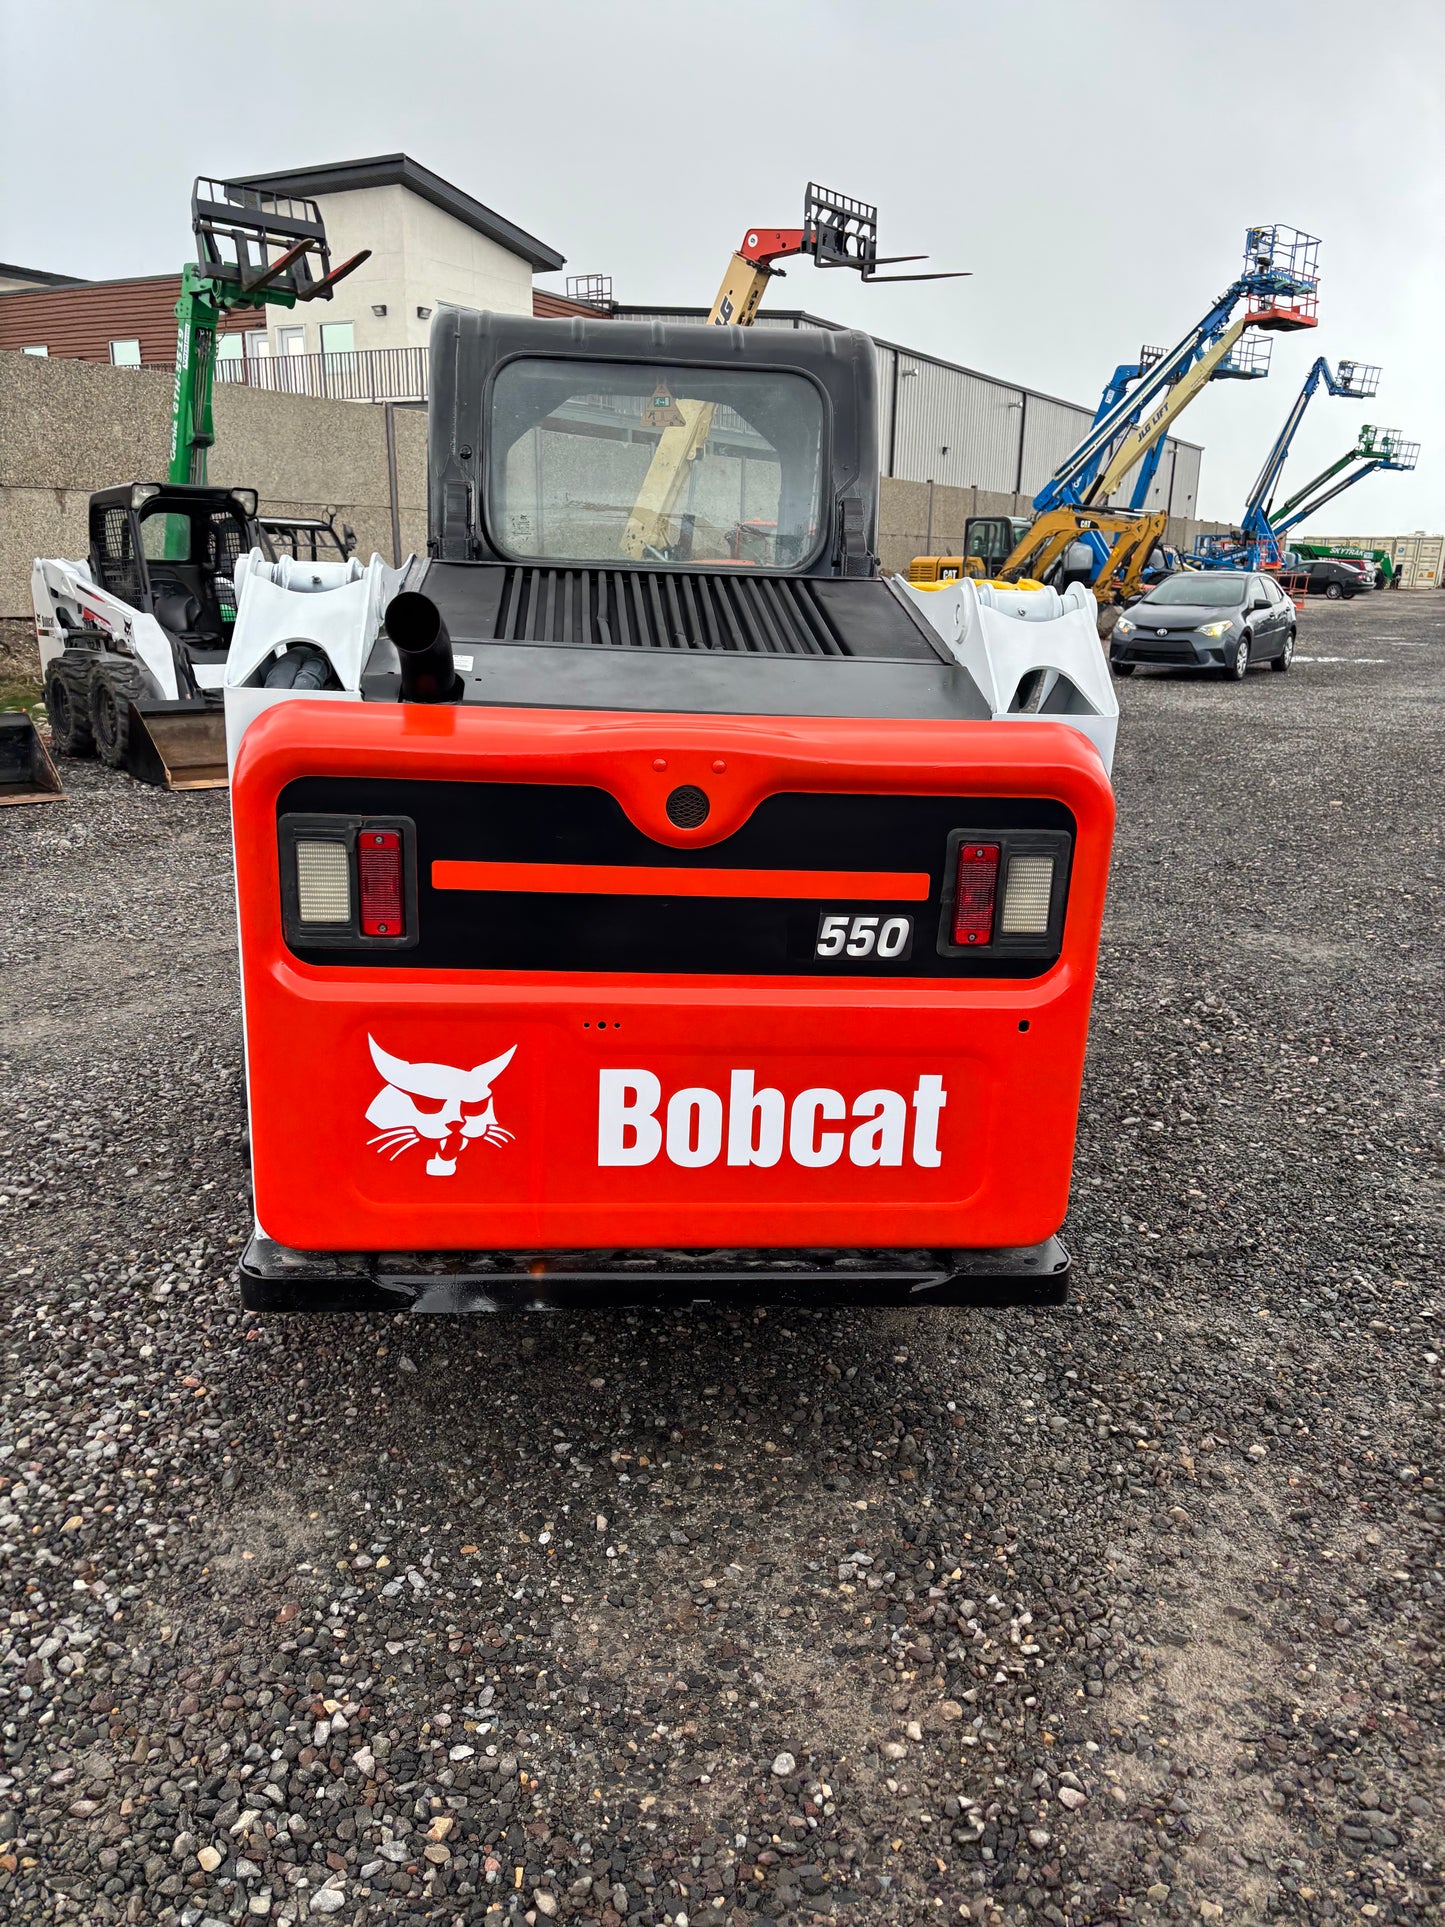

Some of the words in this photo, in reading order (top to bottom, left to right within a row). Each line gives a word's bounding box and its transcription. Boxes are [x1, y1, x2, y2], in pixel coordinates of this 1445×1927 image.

[715, 295, 734, 325] LG
[170, 421, 178, 461] Genie
[1138, 423, 1151, 442] JLG
[1152, 402, 1169, 425] LIFT
[1080, 520, 1091, 529] CAT
[943, 569, 957, 580] CAT
[817, 916, 909, 957] 550
[597, 1068, 947, 1168] Bobcat
